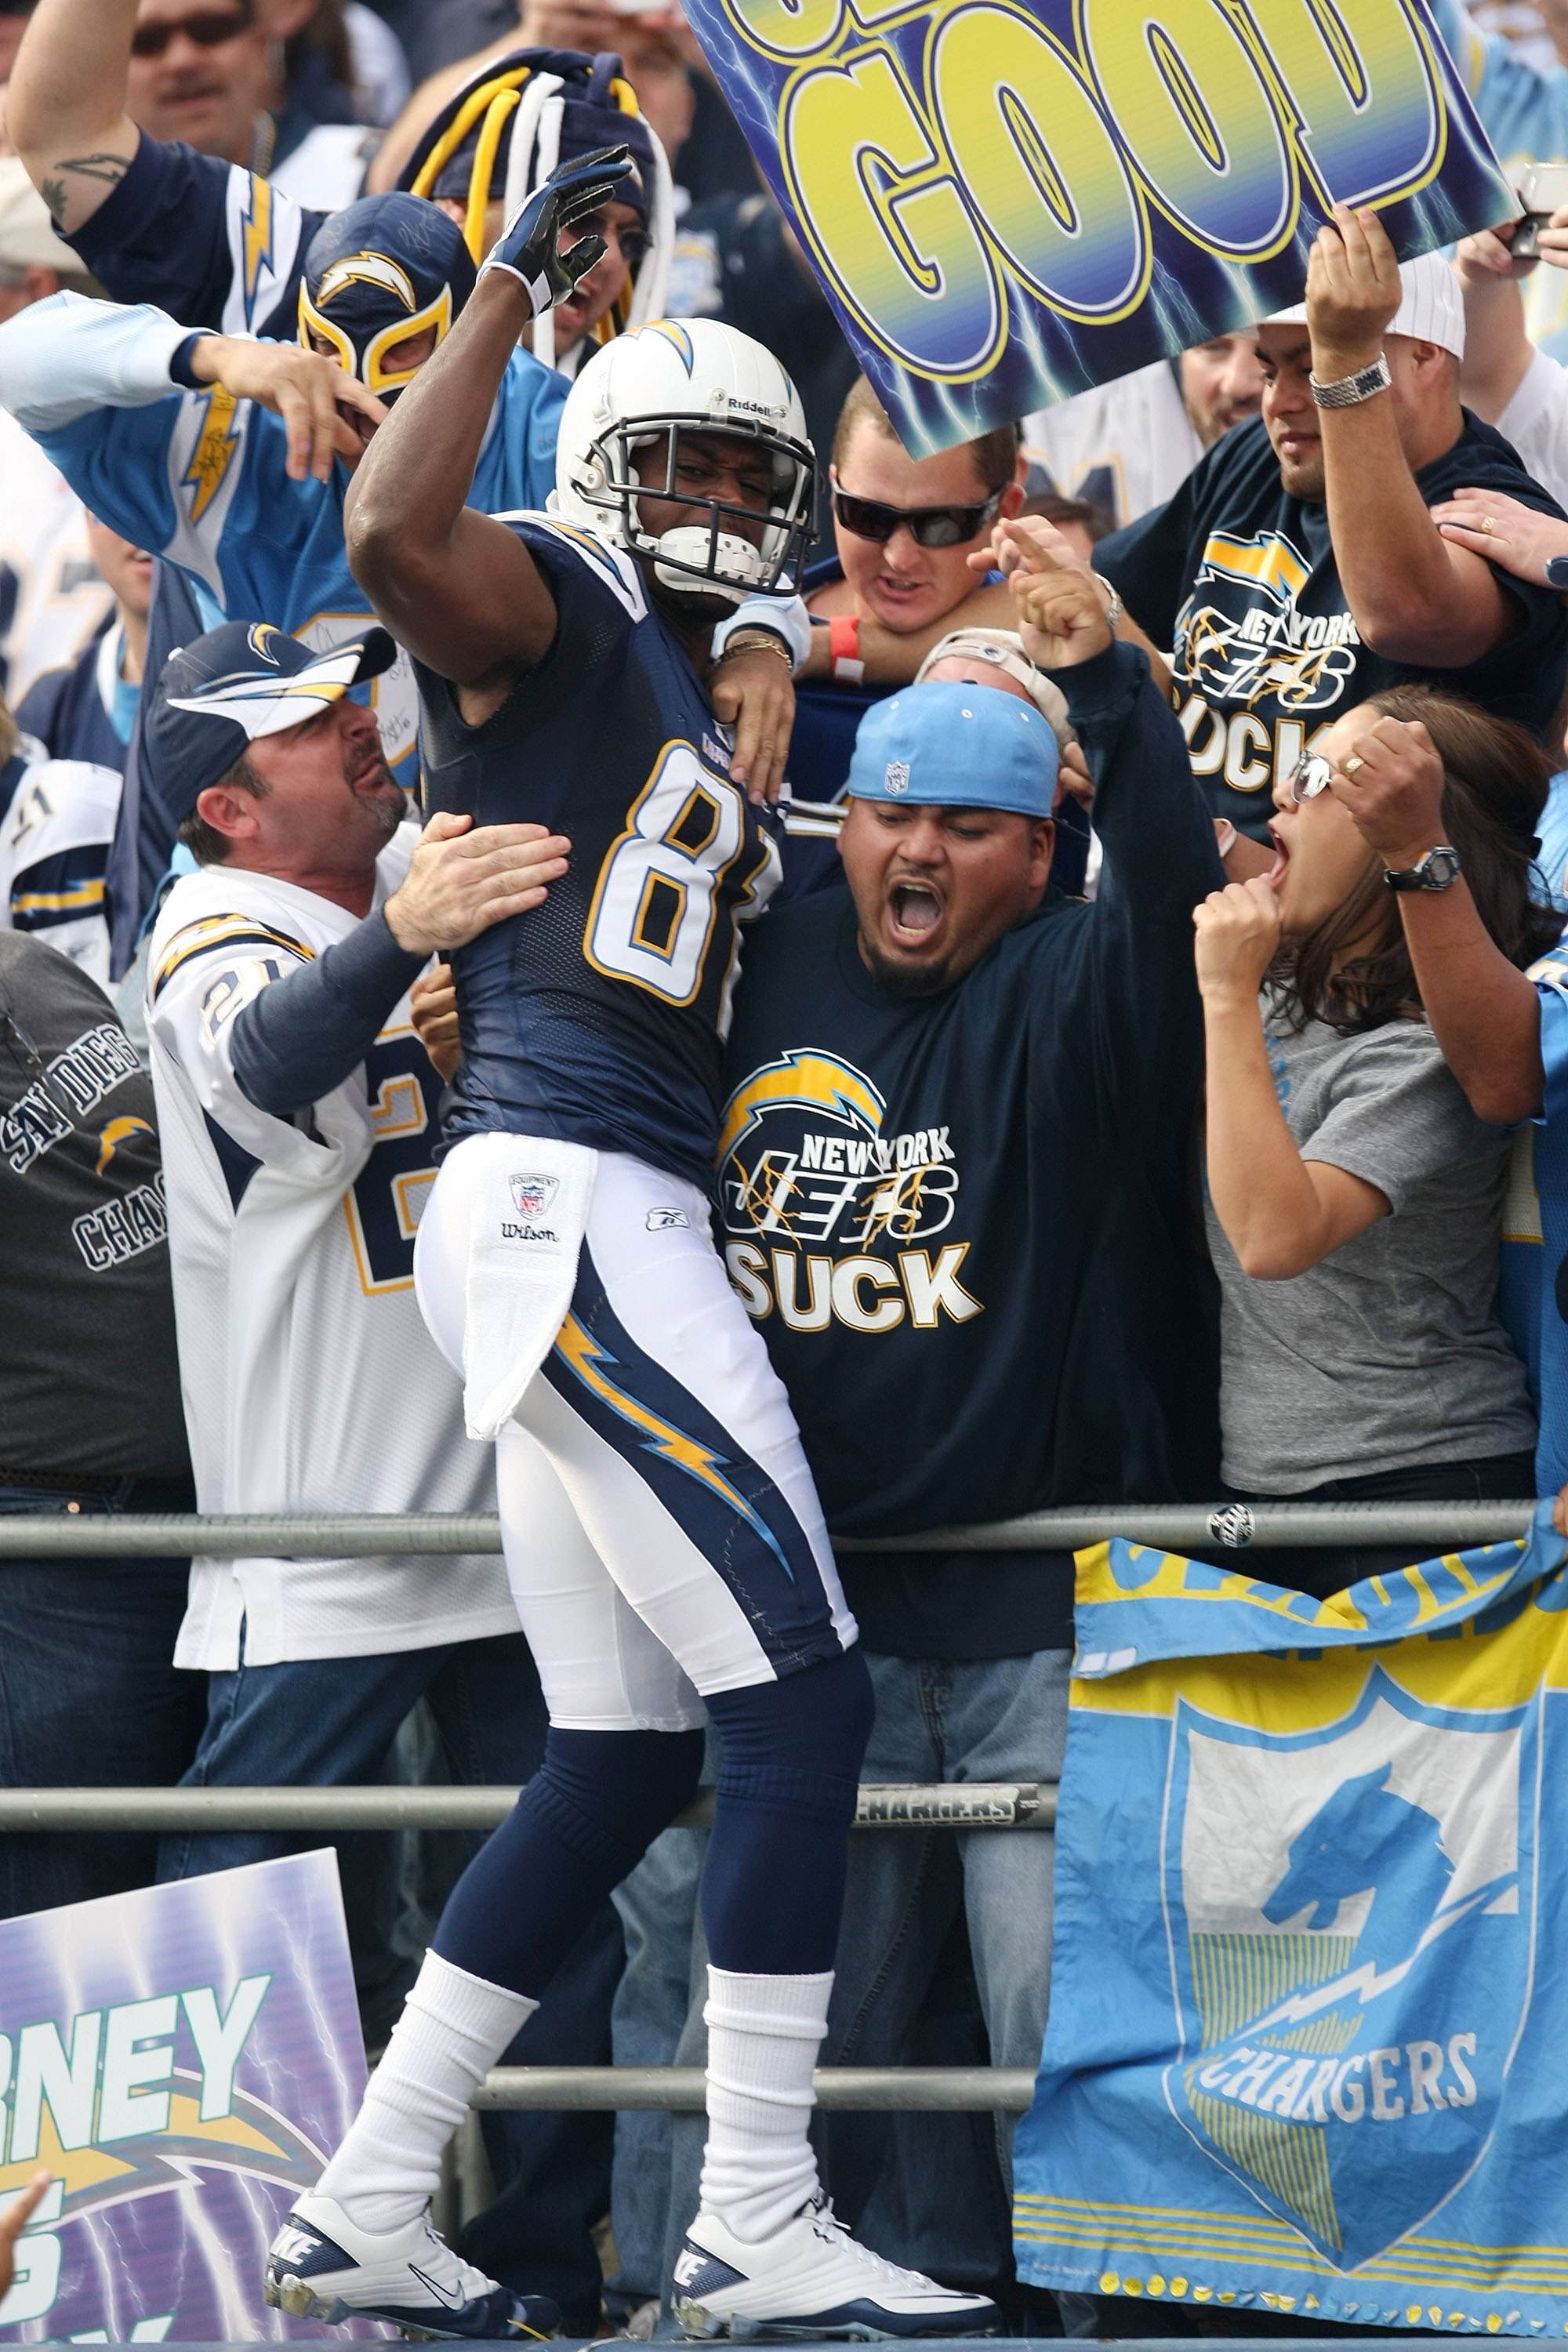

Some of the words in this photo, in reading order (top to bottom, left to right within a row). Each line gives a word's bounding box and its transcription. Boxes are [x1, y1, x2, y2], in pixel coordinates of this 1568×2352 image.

[778, 0, 1448, 385] GOOD
[728, 397, 770, 417] Riddell
[1173, 684, 1334, 792] UCK
[0, 1081, 74, 1174] SAN
[46, 1022, 143, 1116] DIEG
[800, 1134, 874, 1174] NEW
[877, 1126, 956, 1171] YORK
[501, 1222, 559, 1243] Wilson
[725, 1240, 985, 1333] SUCK
[0, 1971, 274, 2166] NEY
[1200, 2031, 1477, 2123] CHARGERS
